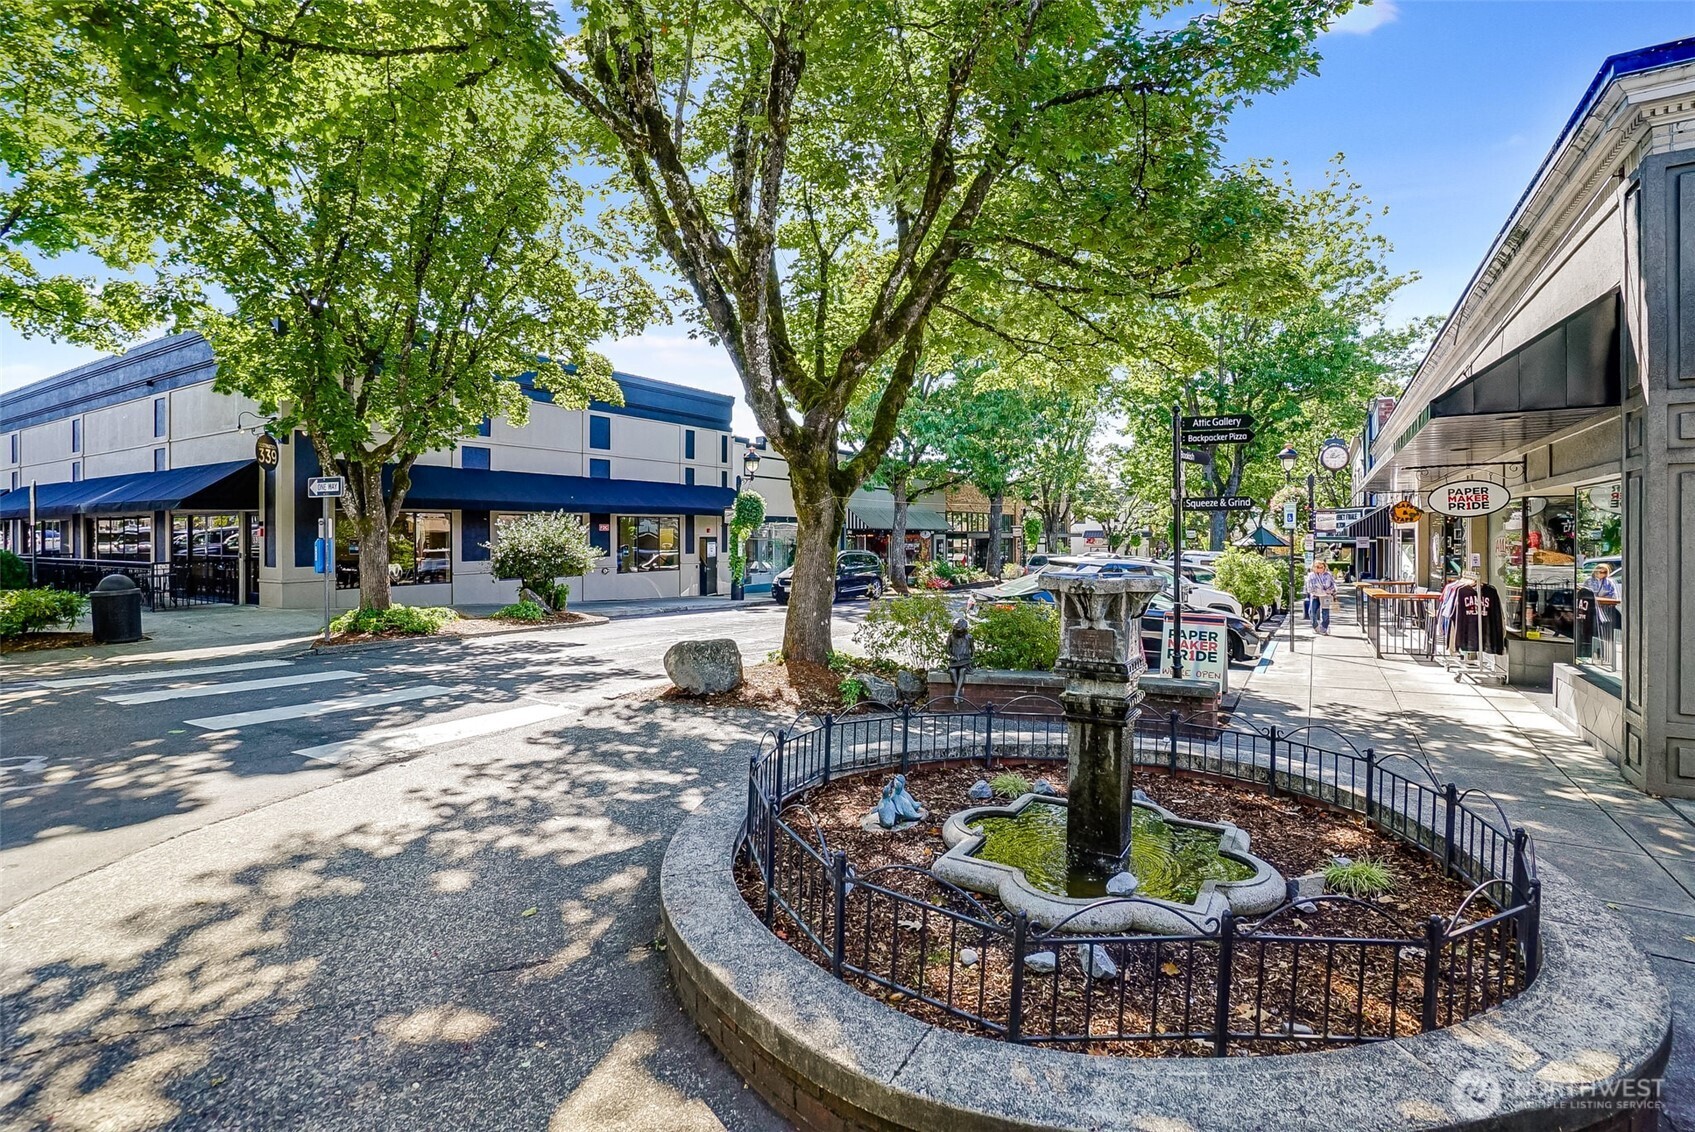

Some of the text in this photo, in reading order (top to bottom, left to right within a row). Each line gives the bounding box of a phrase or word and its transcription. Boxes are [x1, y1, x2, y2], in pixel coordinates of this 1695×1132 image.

[1192, 417, 1241, 427] Attic Gallery
[1187, 432, 1247, 443] Backpacker Pizza
[258, 448, 277, 465] 339
[318, 482, 338, 490] ONE WAY
[1448, 487, 1489, 495] PAPER
[1447, 494, 1489, 502] MAKER
[1185, 498, 1251, 509] Squeeze & Grind
[1168, 629, 1218, 642] PAPER
[1167, 638, 1218, 652] MAKER
[1195, 670, 1221, 679] OPEN
